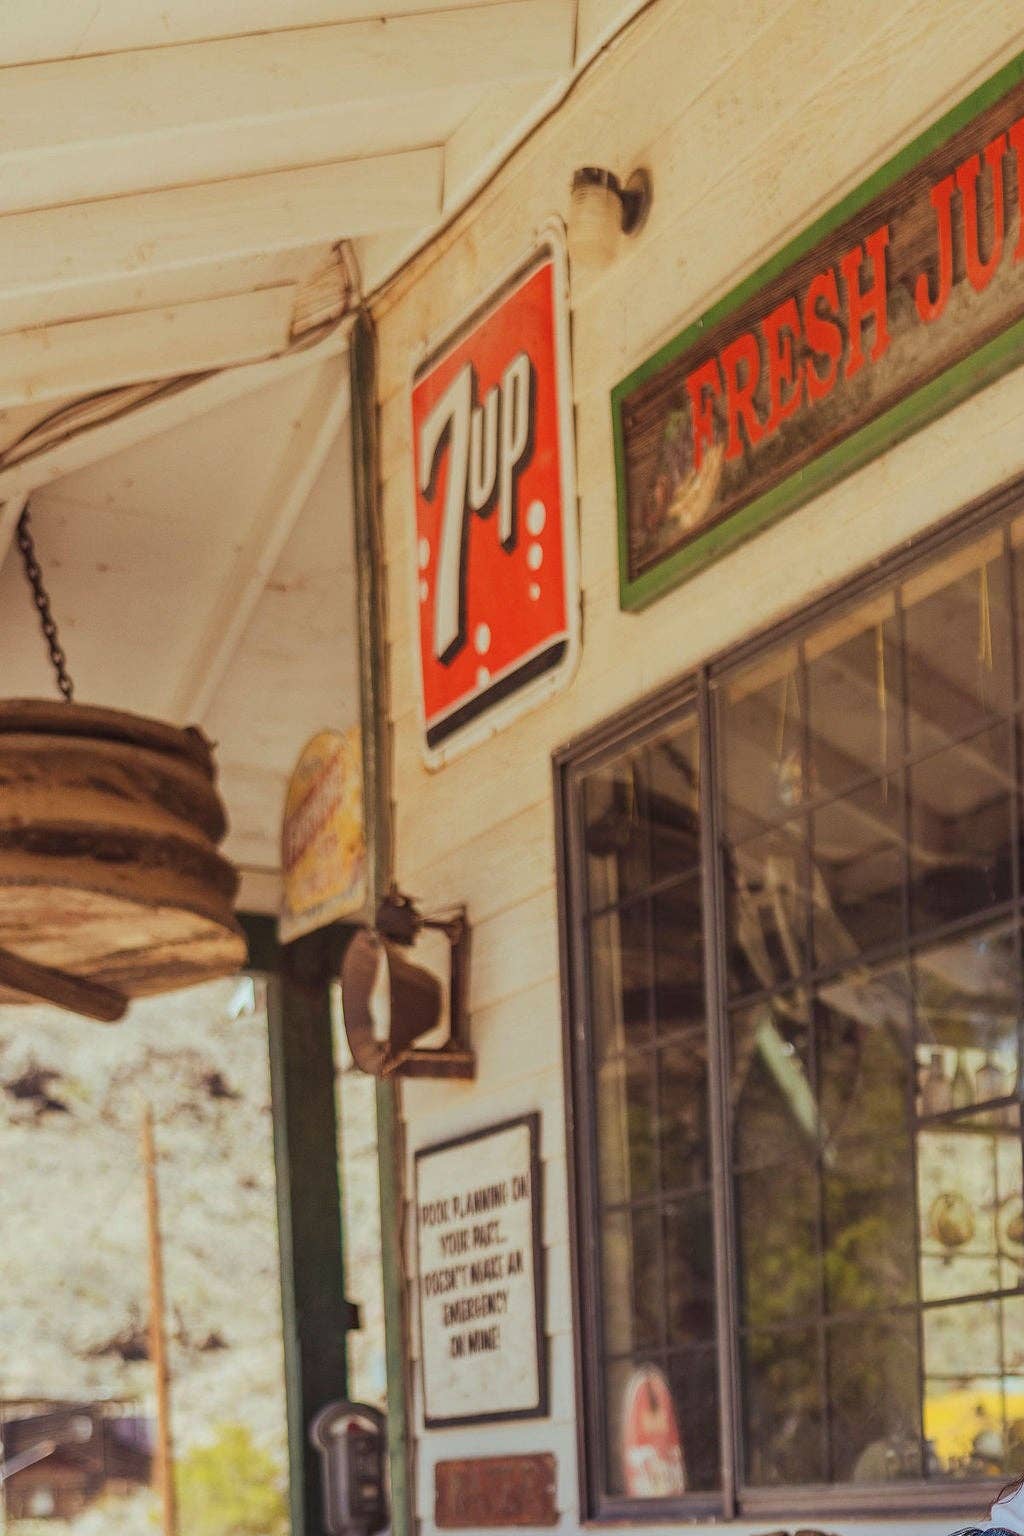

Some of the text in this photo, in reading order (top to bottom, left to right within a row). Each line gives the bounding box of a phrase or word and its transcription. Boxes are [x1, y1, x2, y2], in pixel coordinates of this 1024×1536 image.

[685, 224, 891, 474] FRESH
[452, 1181, 507, 1219] PLANNING
[440, 1229, 468, 1258] YOUR
[470, 1254, 502, 1285] MAKE
[508, 1250, 523, 1275] AN
[443, 1288, 508, 1329] EMERGENCY
